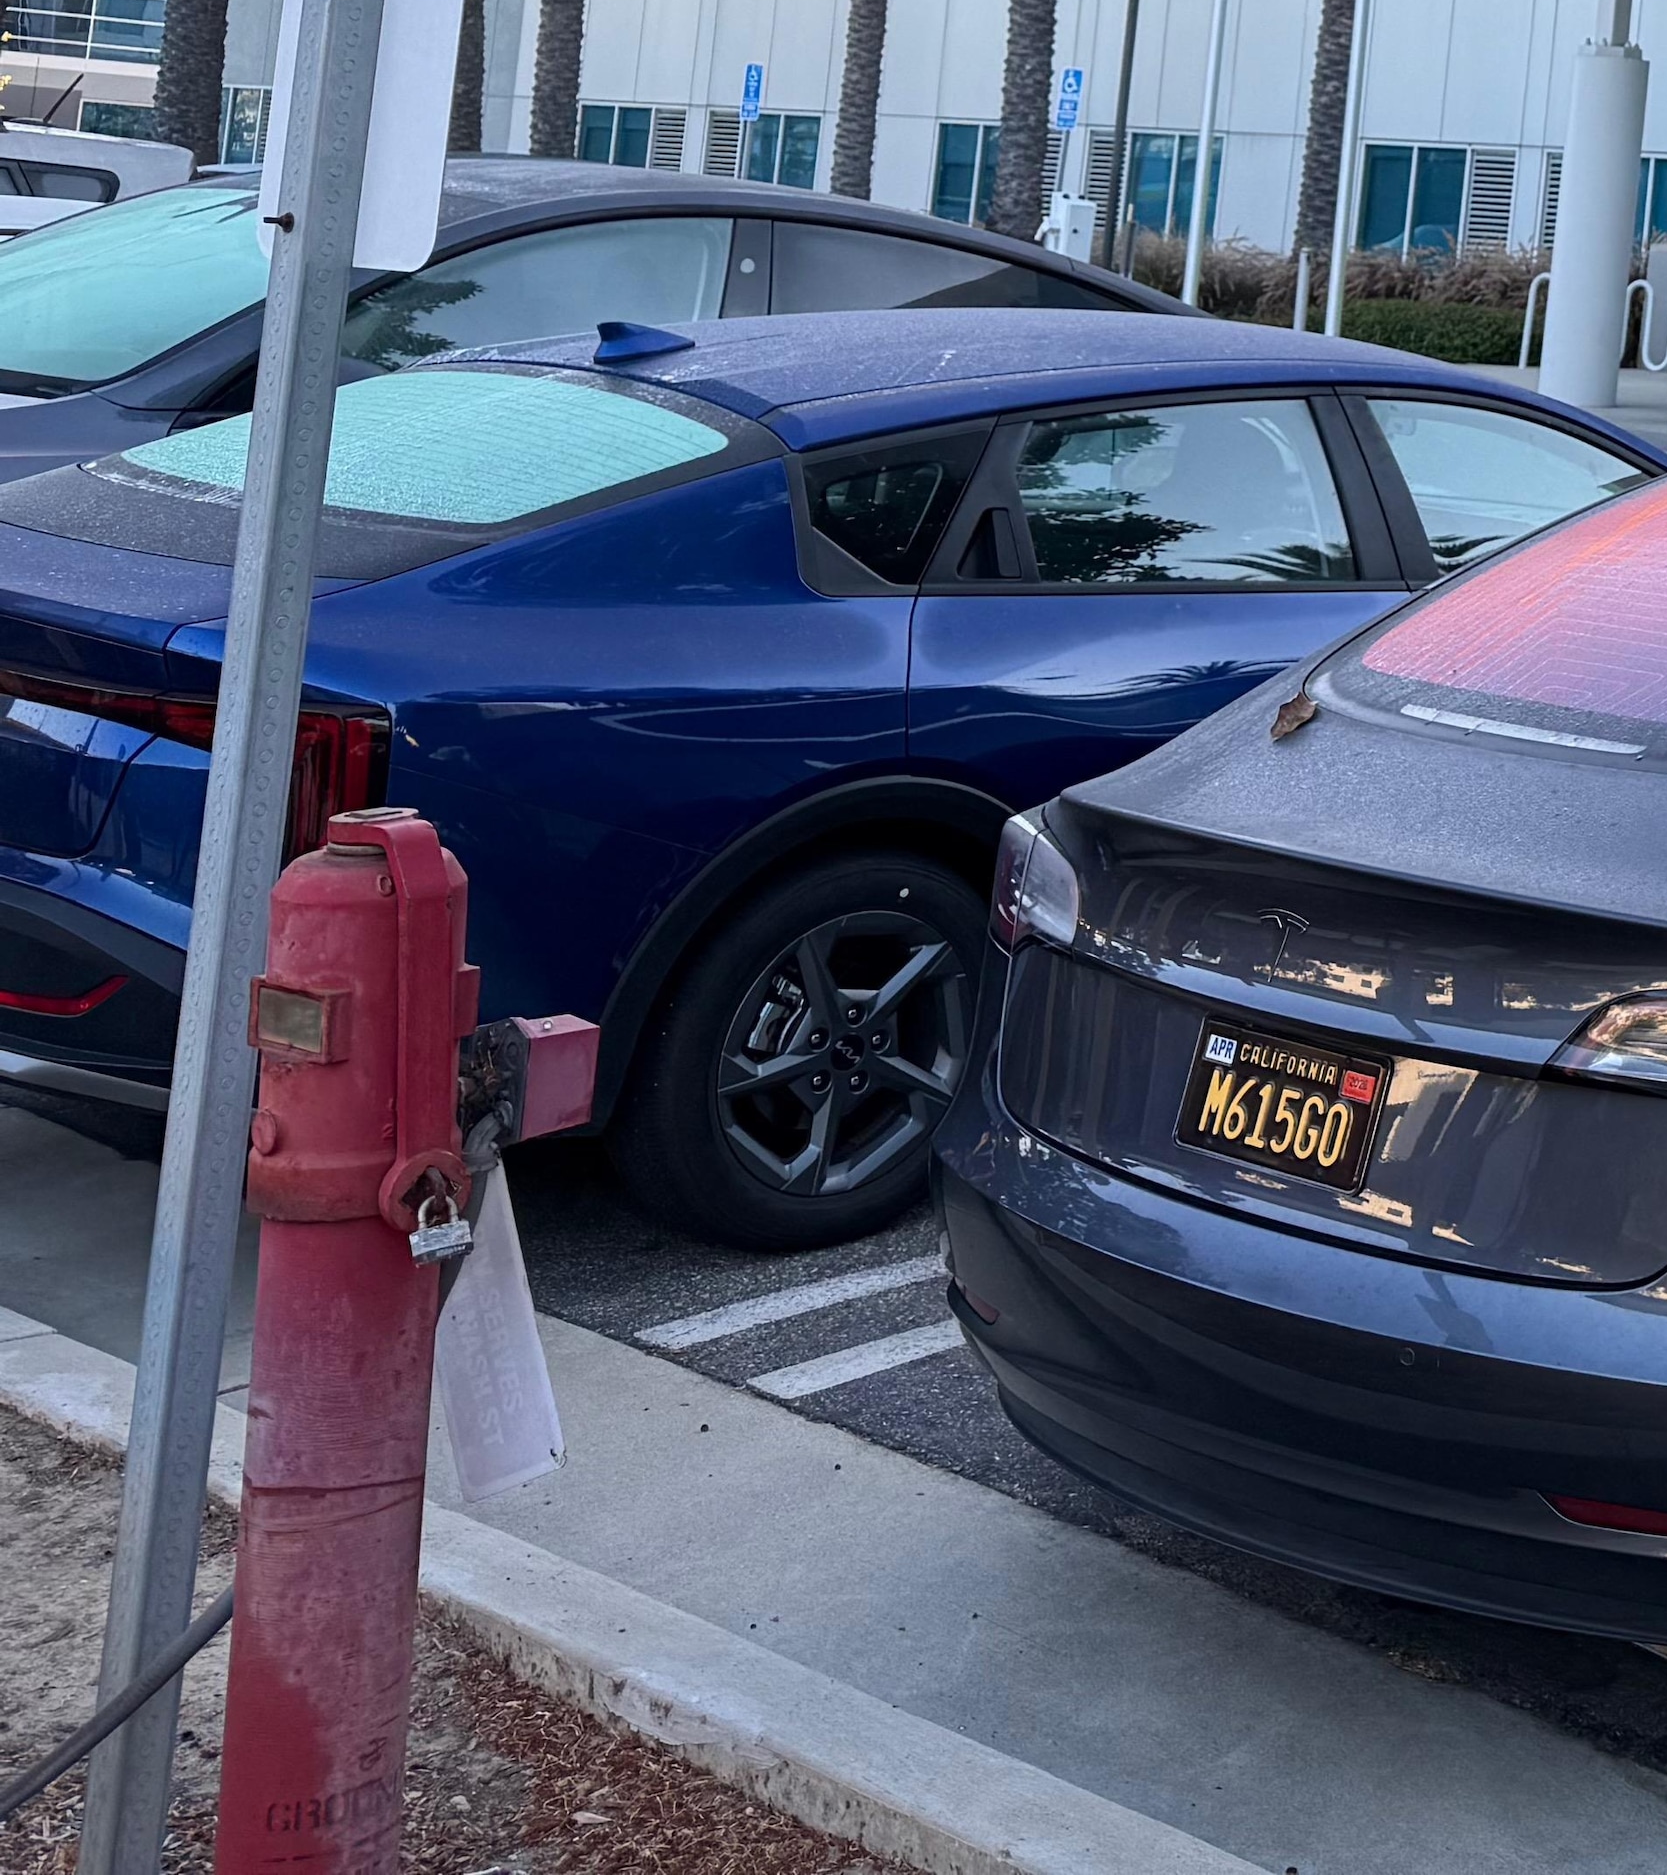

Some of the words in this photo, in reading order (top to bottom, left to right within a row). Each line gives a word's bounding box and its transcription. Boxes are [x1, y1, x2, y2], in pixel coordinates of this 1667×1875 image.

[1209, 1037, 1234, 1060] APR
[1239, 1043, 1337, 1086] CALIFORNIA
[479, 1404, 506, 1447] ST
